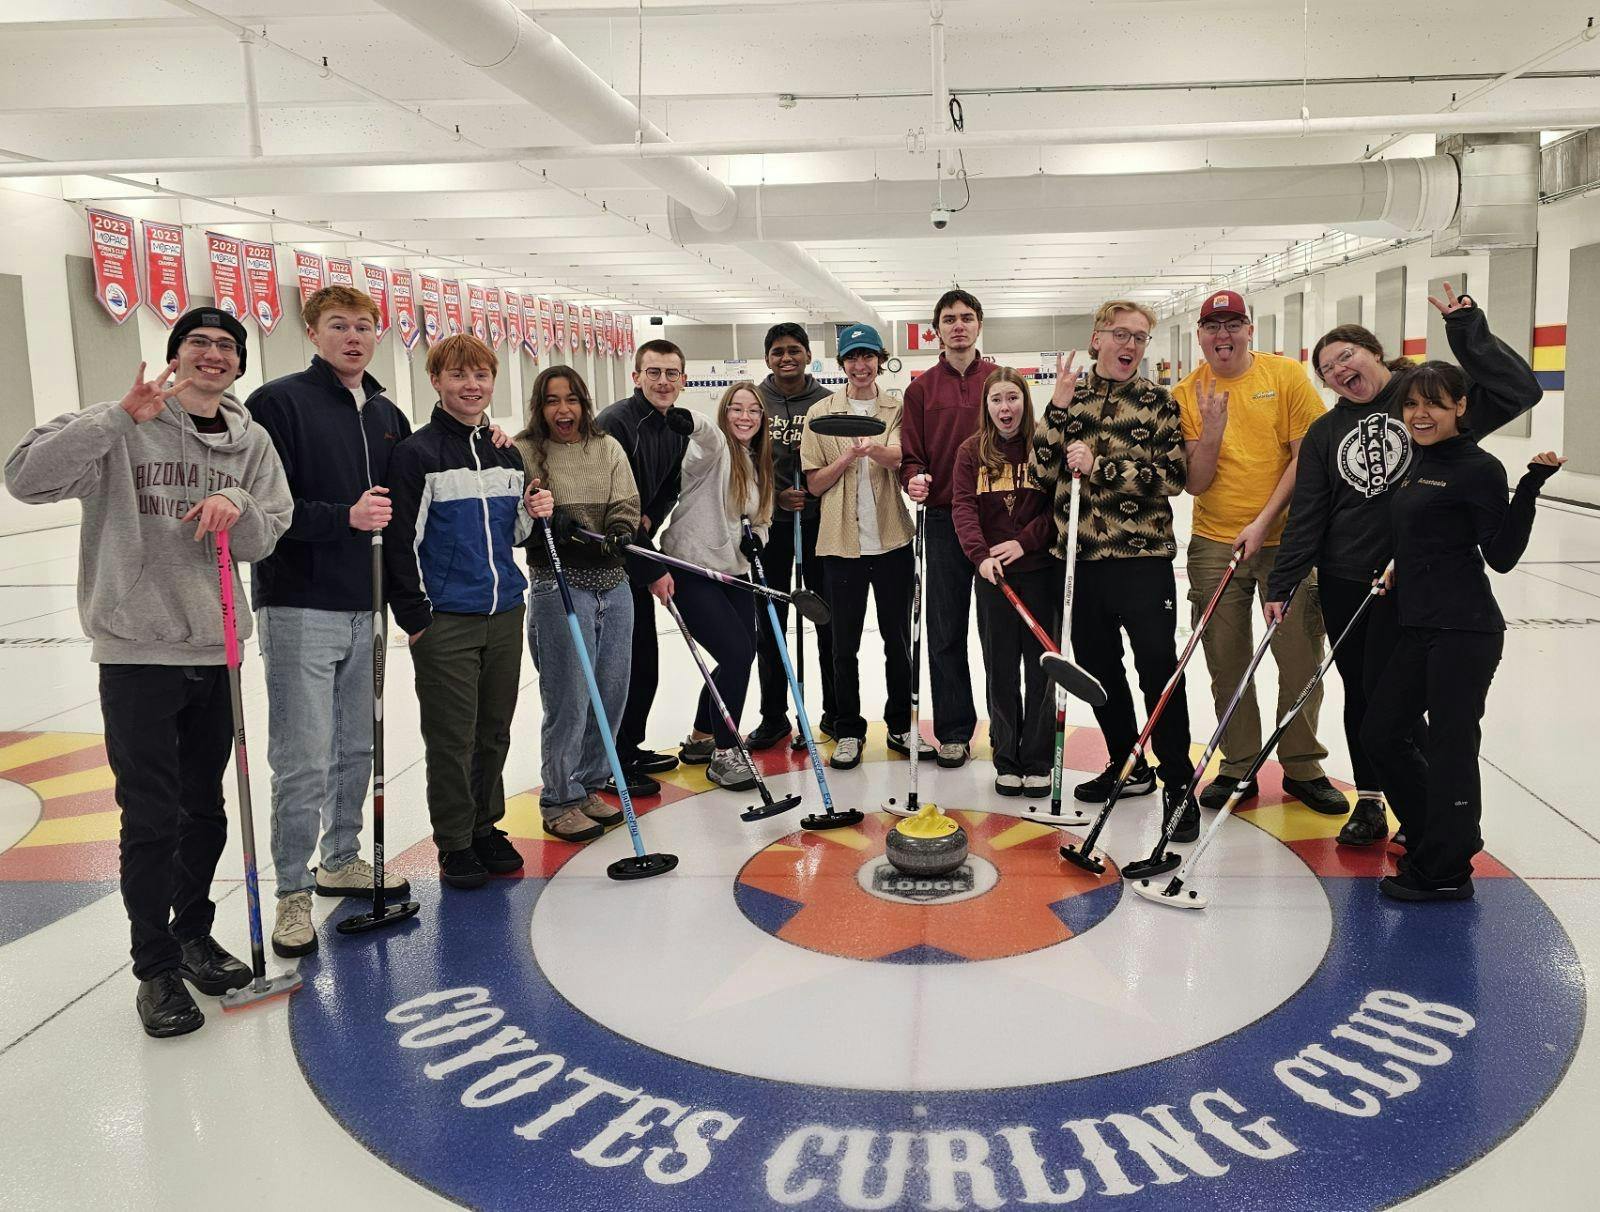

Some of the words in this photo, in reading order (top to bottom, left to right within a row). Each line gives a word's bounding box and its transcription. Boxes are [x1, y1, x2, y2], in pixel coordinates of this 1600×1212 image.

[95, 216, 127, 233] 2023
[96, 231, 128, 247] MOPAC
[151, 228, 179, 242] 2023
[211, 240, 237, 253] 2023
[248, 247, 270, 258] 2022
[300, 256, 319, 268] 2022
[332, 263, 349, 273] 2022
[366, 269, 382, 279] 2022
[768, 415, 790, 430] cky
[793, 414, 807, 425] m
[768, 430, 782, 440] ee
[783, 428, 802, 446] Gh
[1367, 424, 1384, 486] FARGO
[136, 461, 199, 490] RIZONA
[544, 527, 563, 573] BalancePlus
[881, 880, 968, 891] LODGE
[385, 986, 745, 1185] COYOTES
[762, 1087, 1299, 1210] CURLING
[1273, 989, 1476, 1118] CLUB
